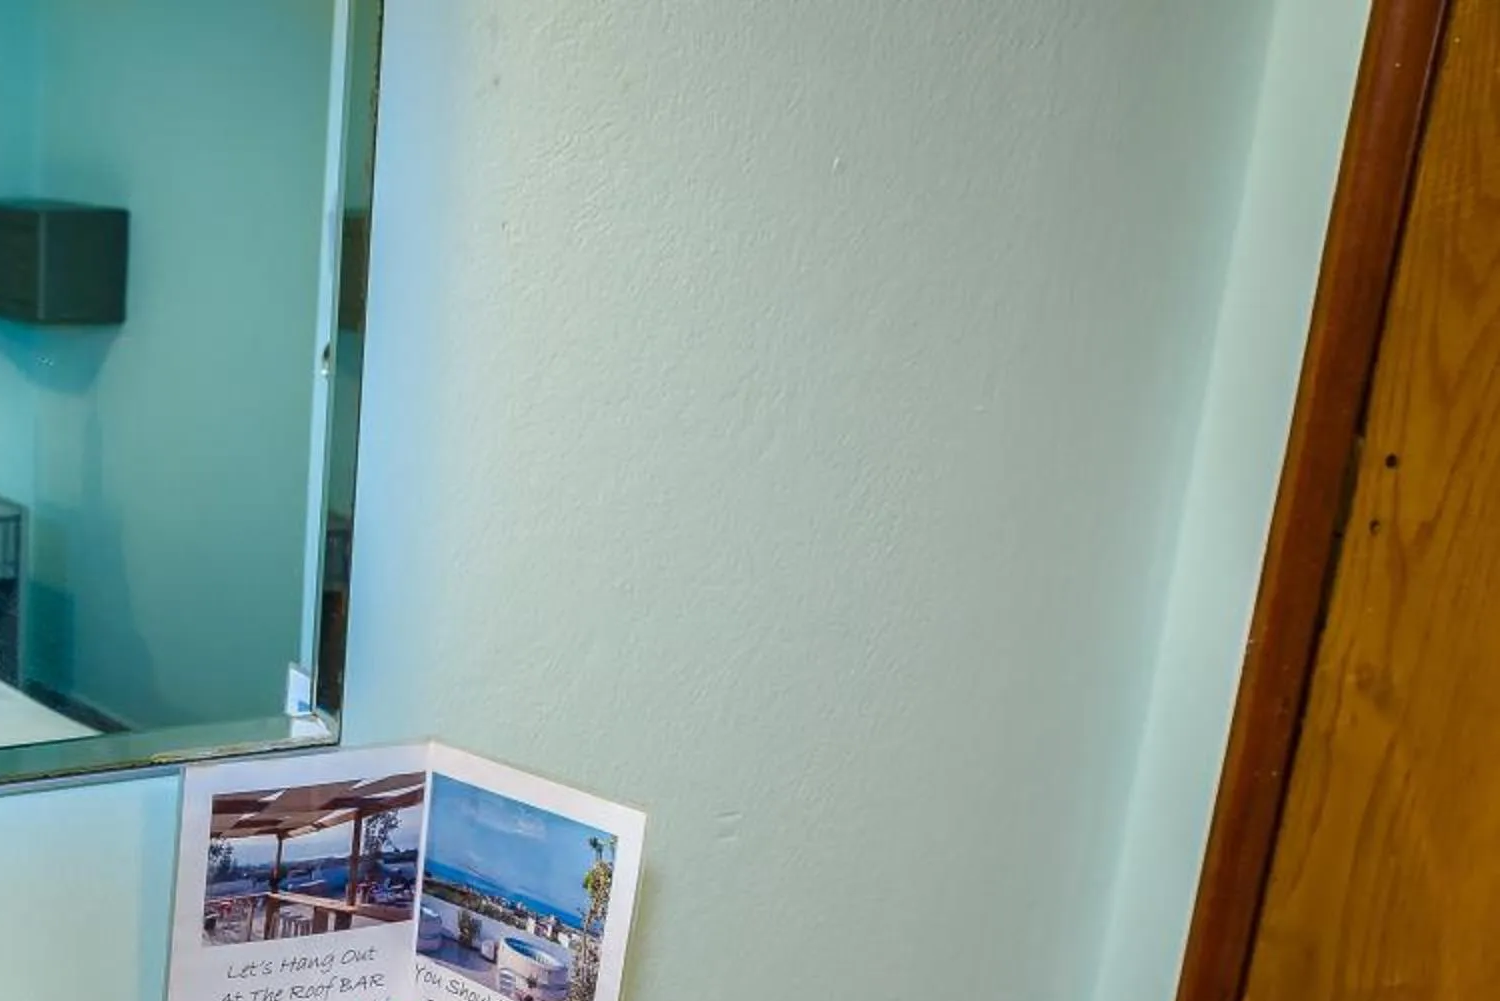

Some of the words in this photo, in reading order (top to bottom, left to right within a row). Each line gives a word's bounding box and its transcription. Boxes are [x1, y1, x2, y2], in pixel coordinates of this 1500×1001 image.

[227, 960, 273, 979] Let's
[279, 954, 335, 975] Hang
[341, 947, 376, 965] Out
[414, 963, 442, 989] You
[288, 976, 336, 1001] Roof
[339, 973, 385, 993] BAR
